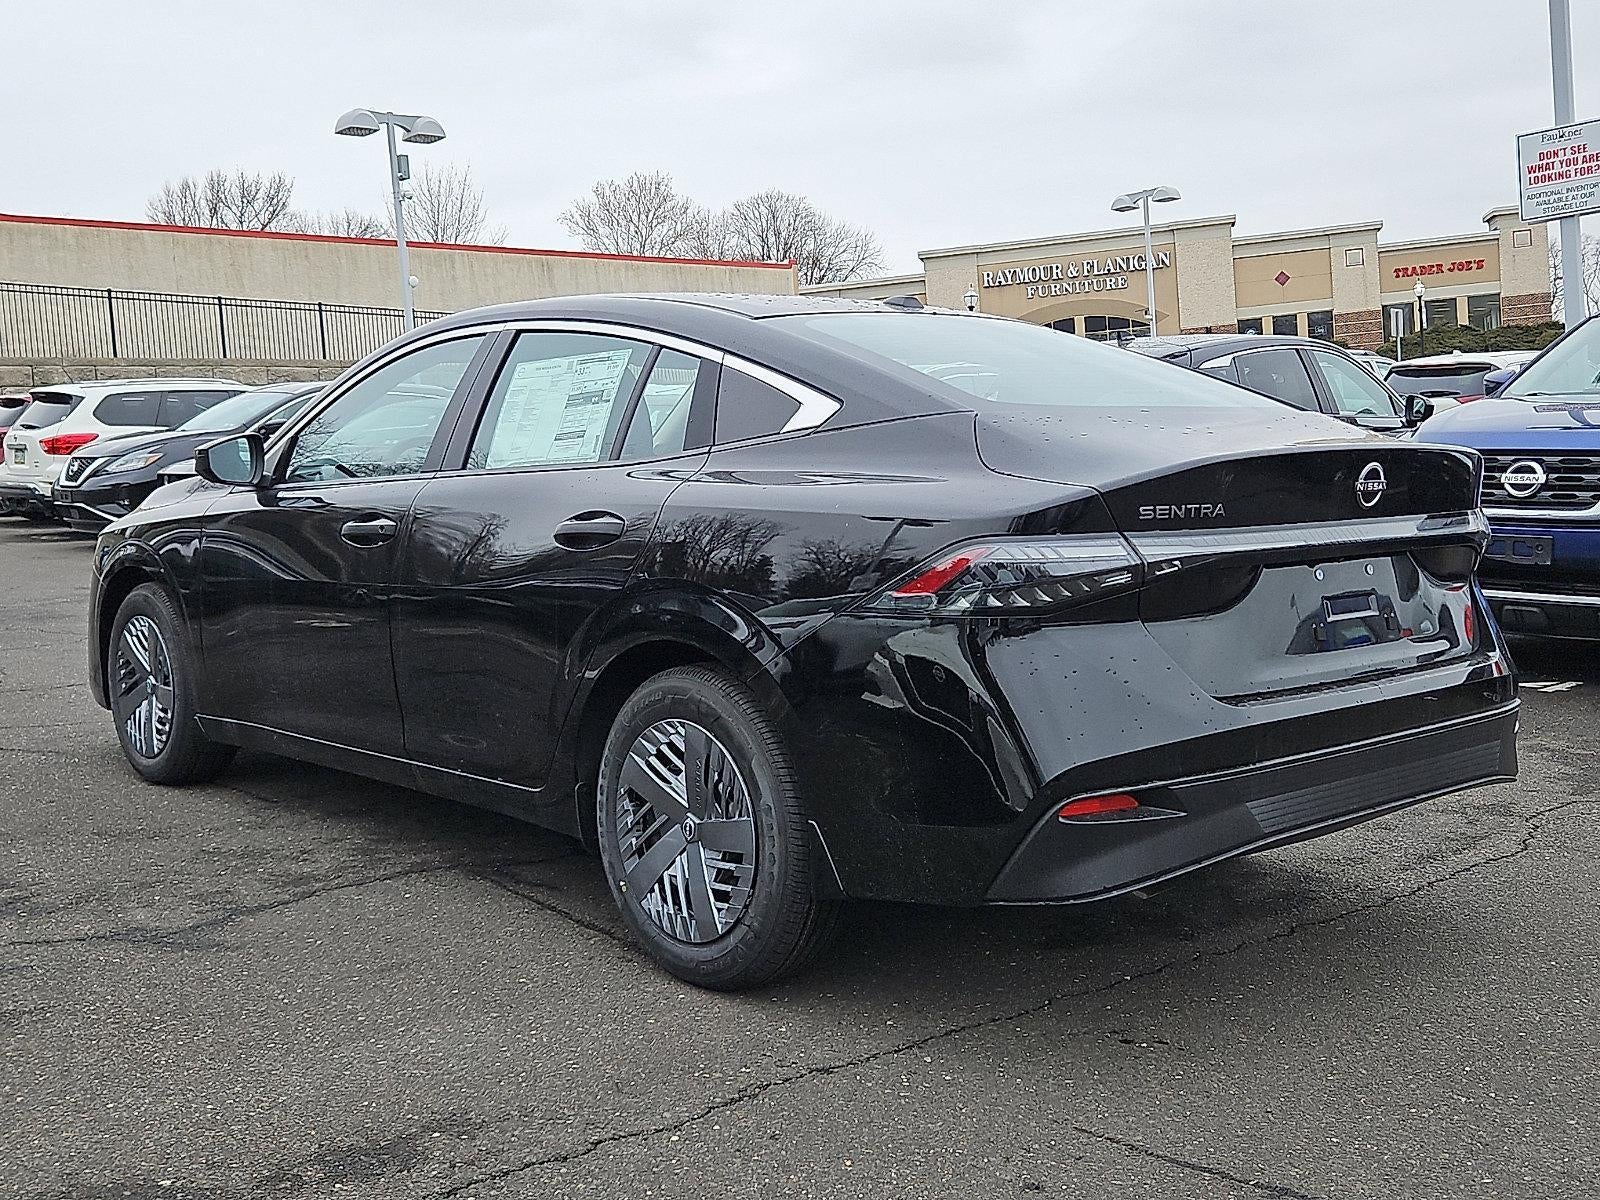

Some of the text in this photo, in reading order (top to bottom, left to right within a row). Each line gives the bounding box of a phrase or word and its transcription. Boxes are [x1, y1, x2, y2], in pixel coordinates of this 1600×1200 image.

[1541, 128, 1583, 143] Faulkner
[1538, 143, 1588, 162] DON'T SEE
[1526, 152, 1600, 175] WHAT YOU ARE
[1528, 163, 1600, 186] LOOKING FOR?
[1526, 189, 1565, 201] ADDITIONAL
[1535, 190, 1595, 207] AVAILABLE AT OUR
[1542, 199, 1588, 215] STORAGE LOT
[982, 250, 1171, 289] RAYMOUR & FLANIGAN
[1393, 259, 1486, 279] TRADER JOE'S
[1026, 275, 1128, 299] FURNITURE
[1356, 482, 1387, 491] NISSAN
[1504, 475, 1541, 483] NISSAN
[1138, 503, 1226, 520] SENTRA
